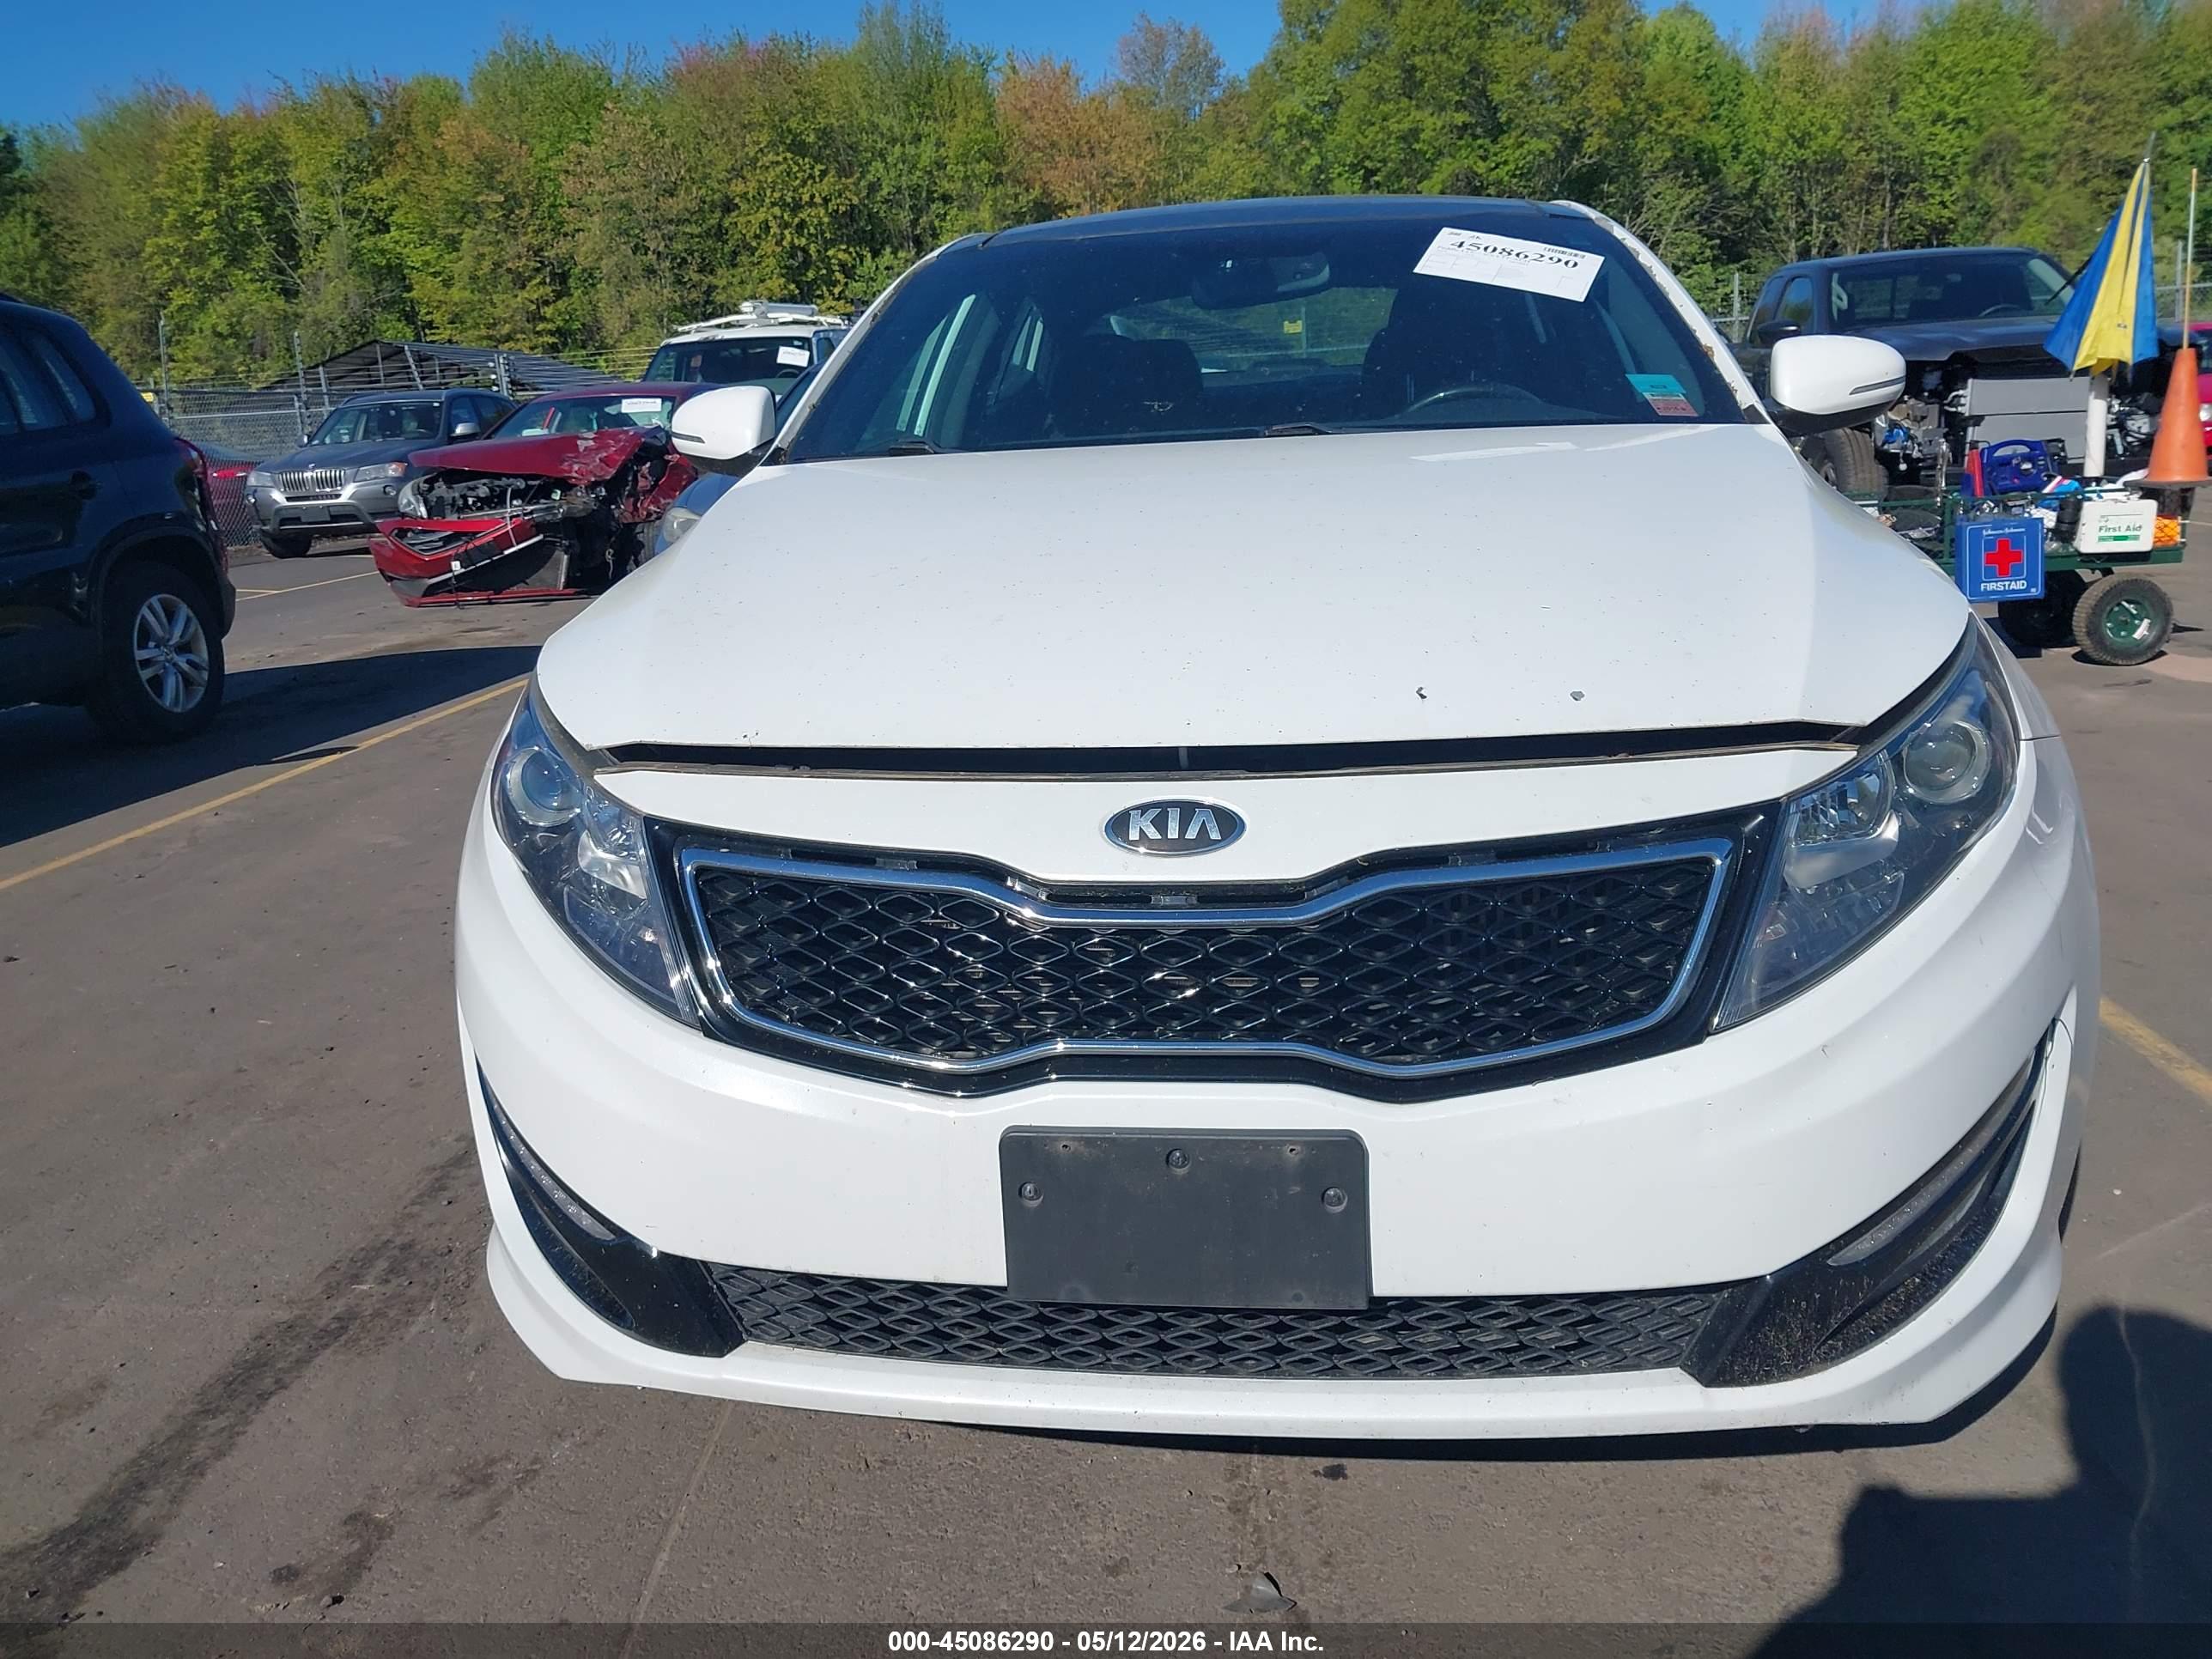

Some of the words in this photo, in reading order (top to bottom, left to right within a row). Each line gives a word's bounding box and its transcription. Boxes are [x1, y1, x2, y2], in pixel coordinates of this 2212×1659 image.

[1449, 240, 1579, 269] 45086290
[2125, 523, 2142, 532] Aid
[1127, 807, 1222, 842] KIA
